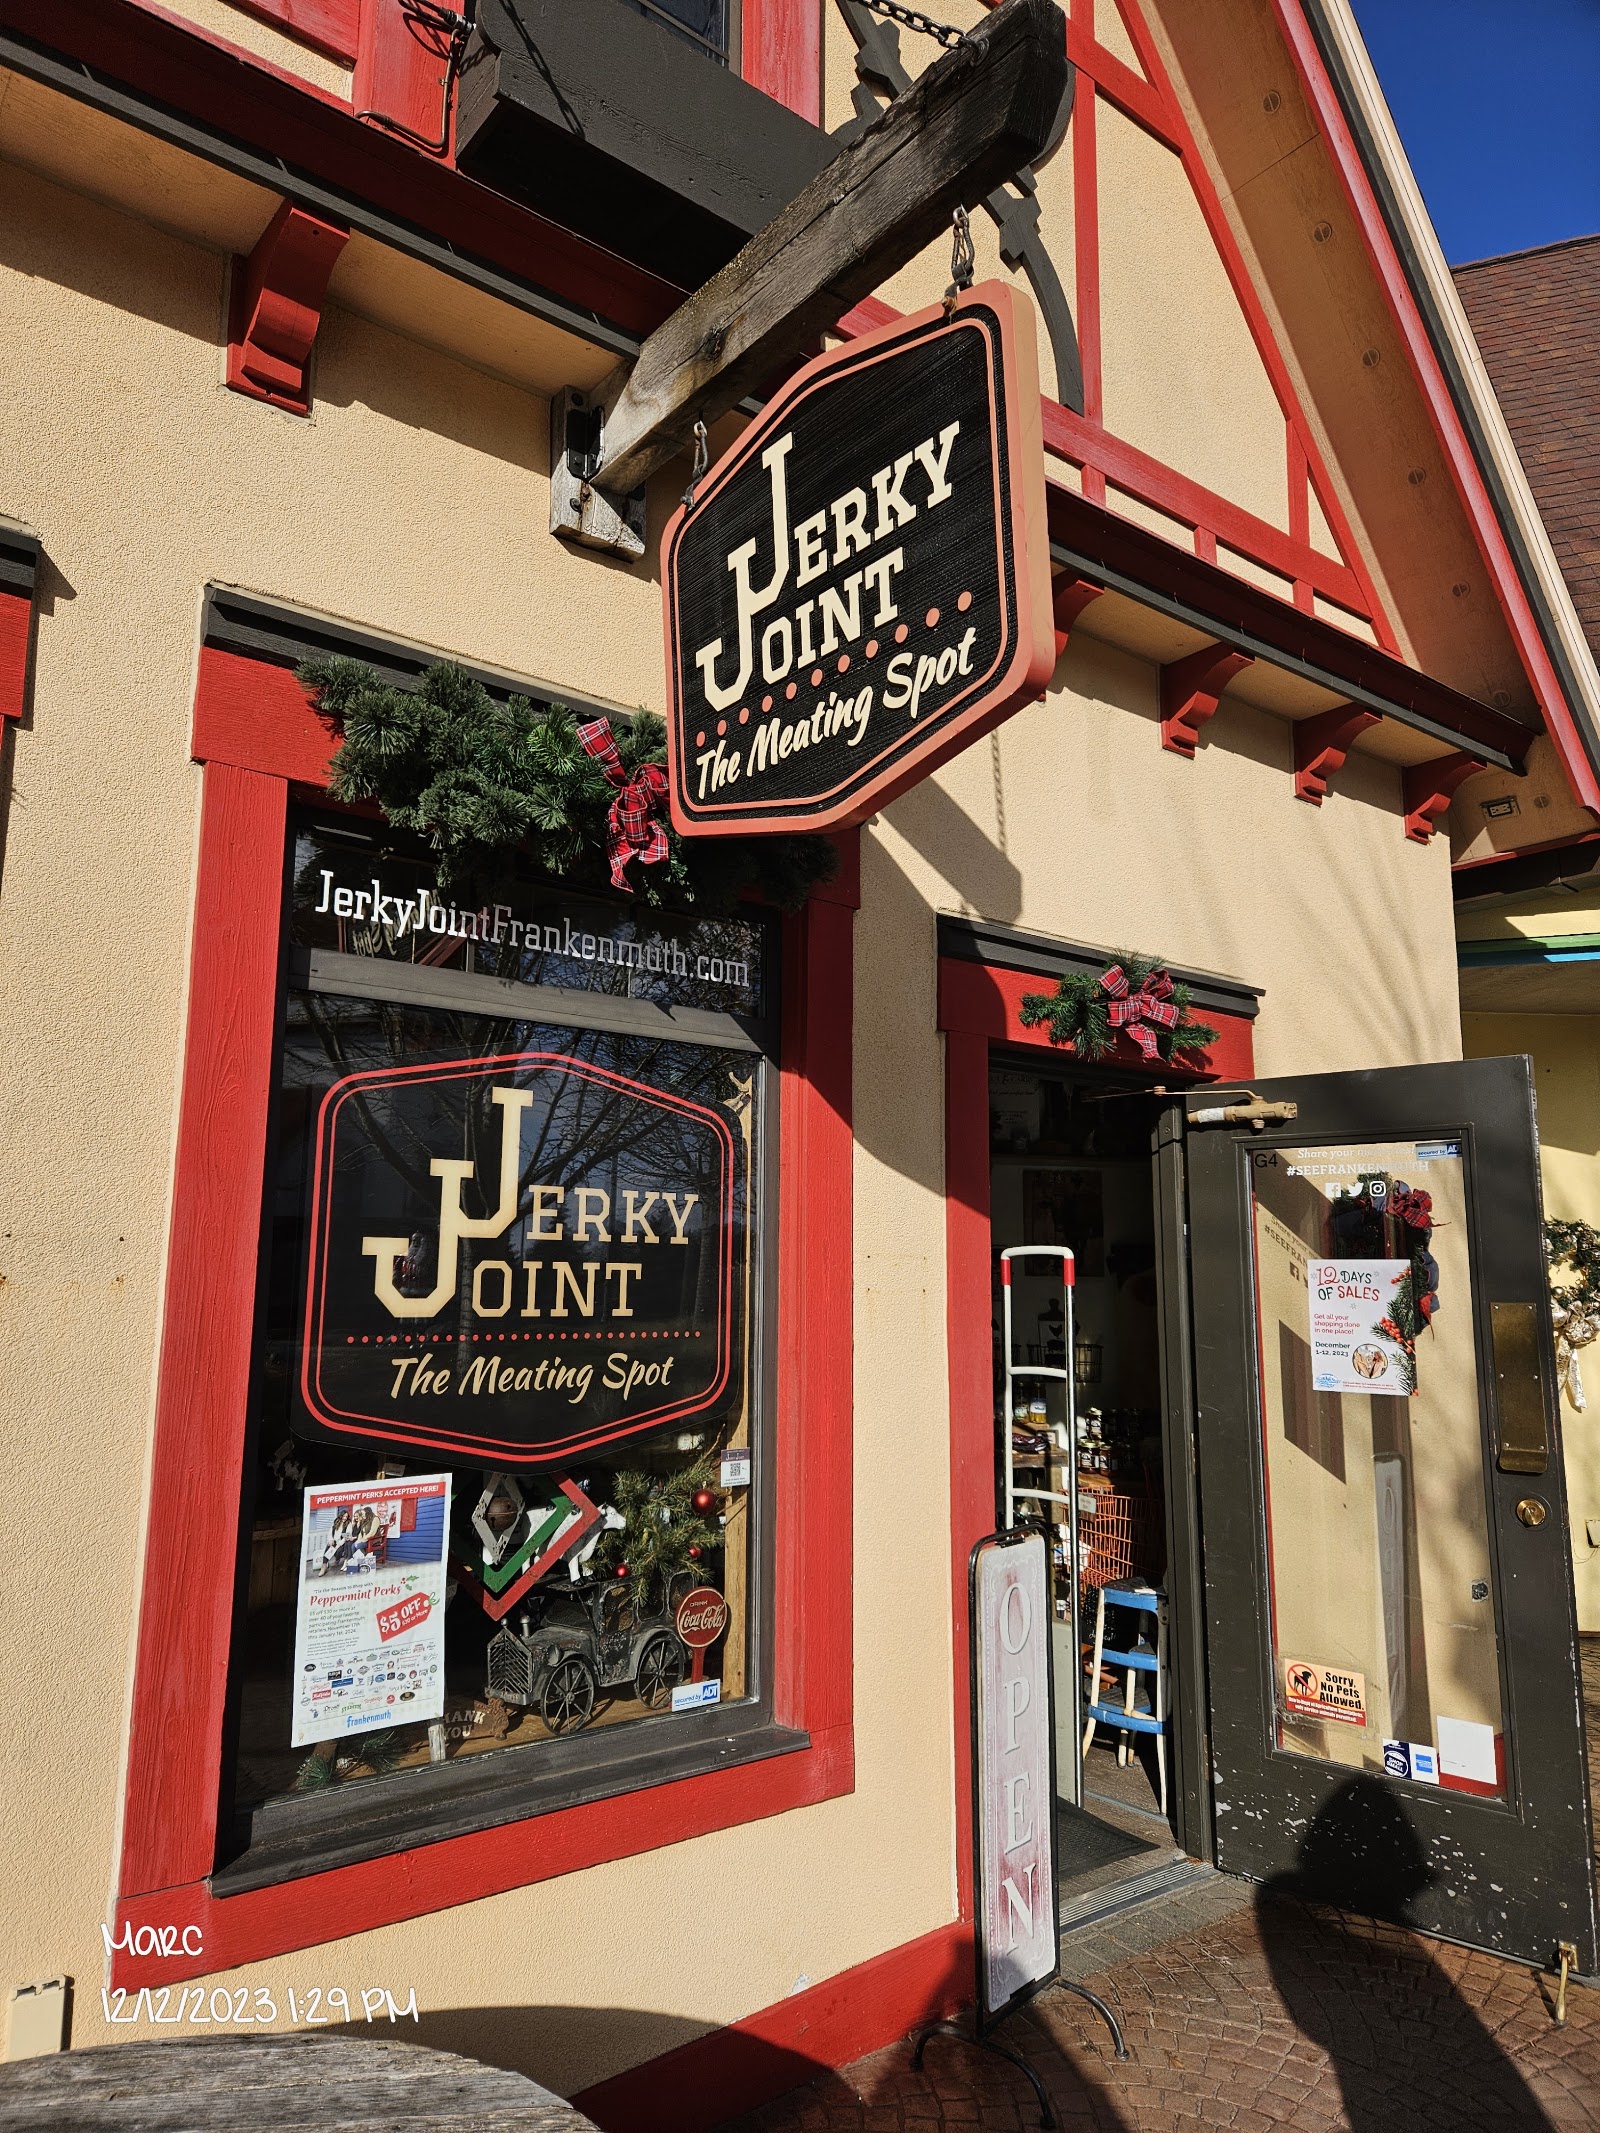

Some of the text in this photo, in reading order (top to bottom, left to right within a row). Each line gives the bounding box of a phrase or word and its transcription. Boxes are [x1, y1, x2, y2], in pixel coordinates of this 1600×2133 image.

[751, 421, 960, 613] JERKY
[695, 537, 904, 713] JOINT
[696, 628, 977, 799] The Meating Spot
[315, 869, 750, 988] JerkyJointFrankenmuth.com
[1254, 1153, 1278, 1168] G4
[1298, 1149, 1328, 1159] Share
[1330, 1148, 1355, 1162] your
[458, 1086, 699, 1246] JERKY
[361, 1159, 642, 1319] JOINT
[1316, 1266, 1372, 1287] 12 DAYS
[1318, 1285, 1380, 1302] OF SALES
[1314, 1320, 1343, 1329] shopping
[1315, 1341, 1350, 1349] December
[390, 1352, 674, 1404] The Meating Spot
[317, 1494, 361, 1504] PEPPERMINT
[361, 1490, 383, 1499] PERKS
[384, 1487, 419, 1497] ACCEPTED
[310, 1584, 401, 1608] Peppermint Perks
[380, 1597, 421, 1634] $5 OFF
[674, 1694, 701, 1704] secured by
[703, 1686, 718, 1698] ADT
[1320, 1682, 1360, 1699] No Pets
[1319, 1692, 1365, 1711] Allowed.
[346, 1709, 392, 1728] frankenmuth
[999, 1581, 1036, 1957] OPEN
